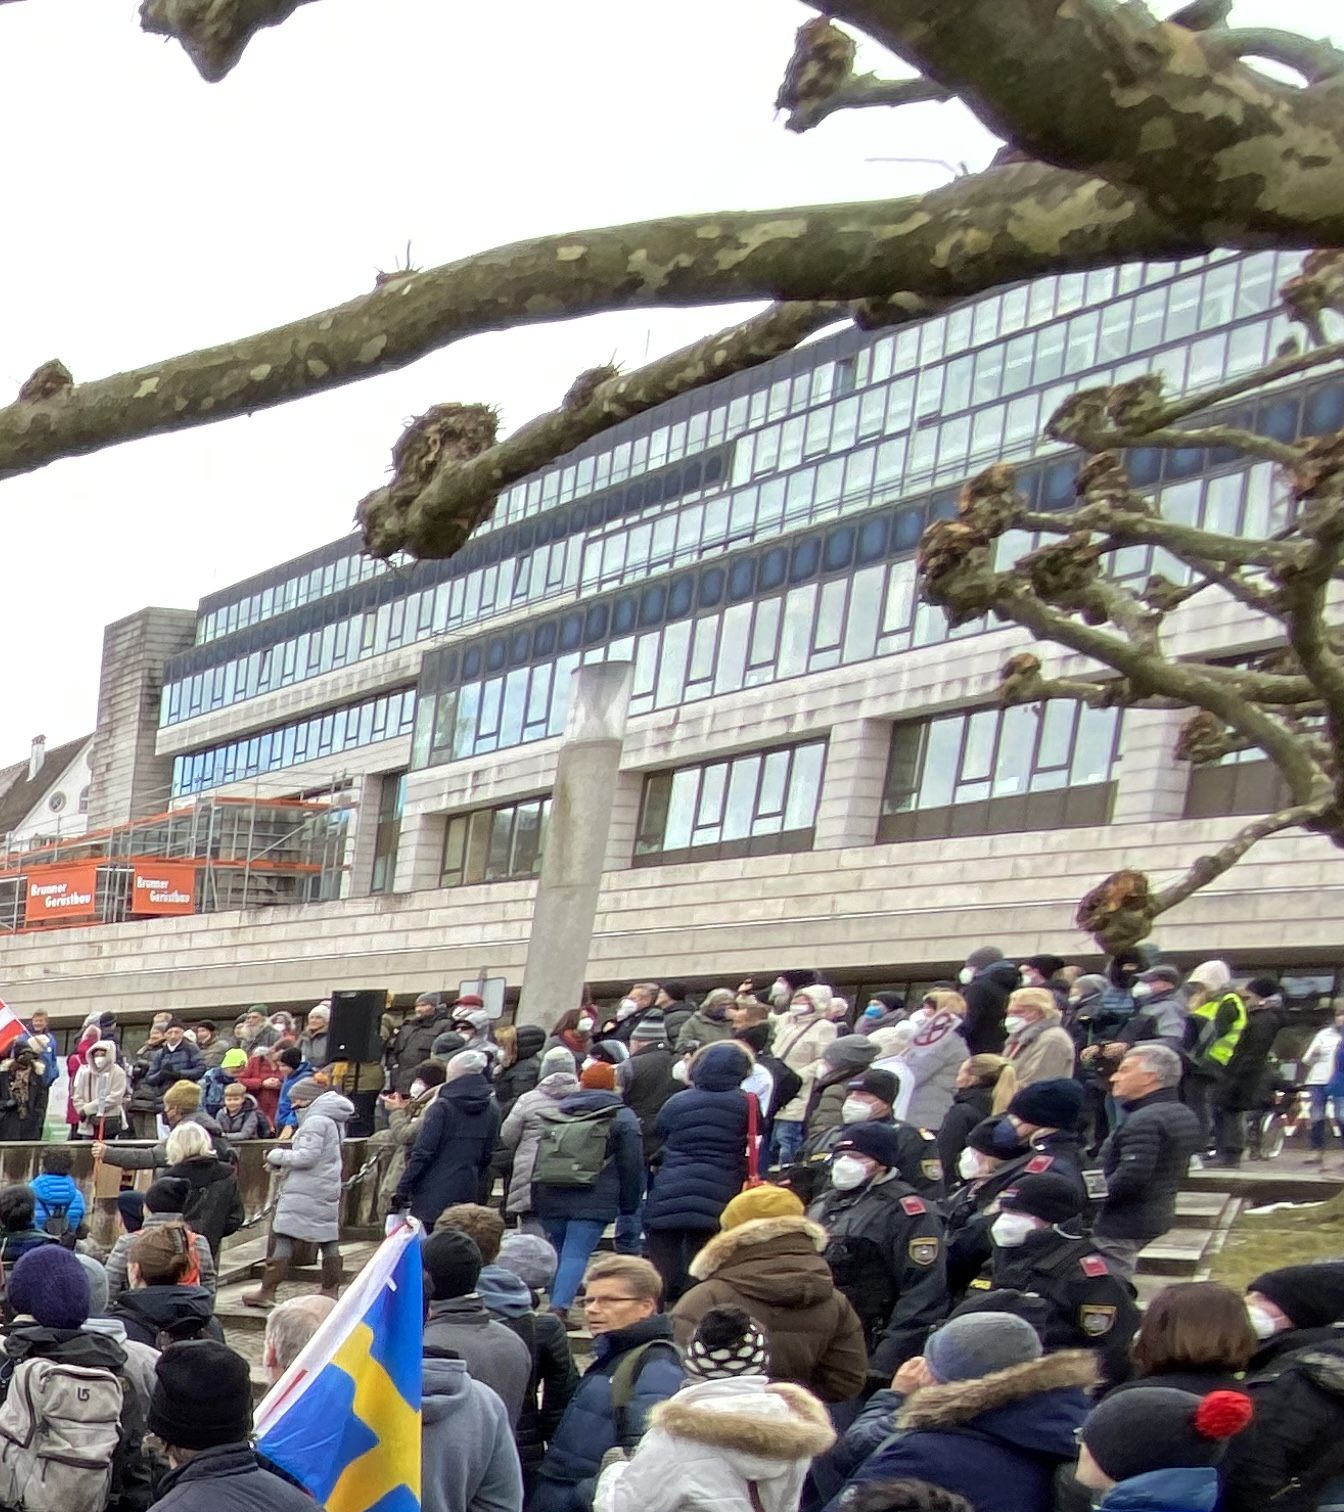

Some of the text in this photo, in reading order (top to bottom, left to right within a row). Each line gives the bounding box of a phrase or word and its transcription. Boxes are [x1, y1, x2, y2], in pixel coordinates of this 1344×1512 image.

[30, 883, 68, 897] Brunner
[136, 876, 169, 890] Brunner
[45, 891, 92, 909] Gerüstbau
